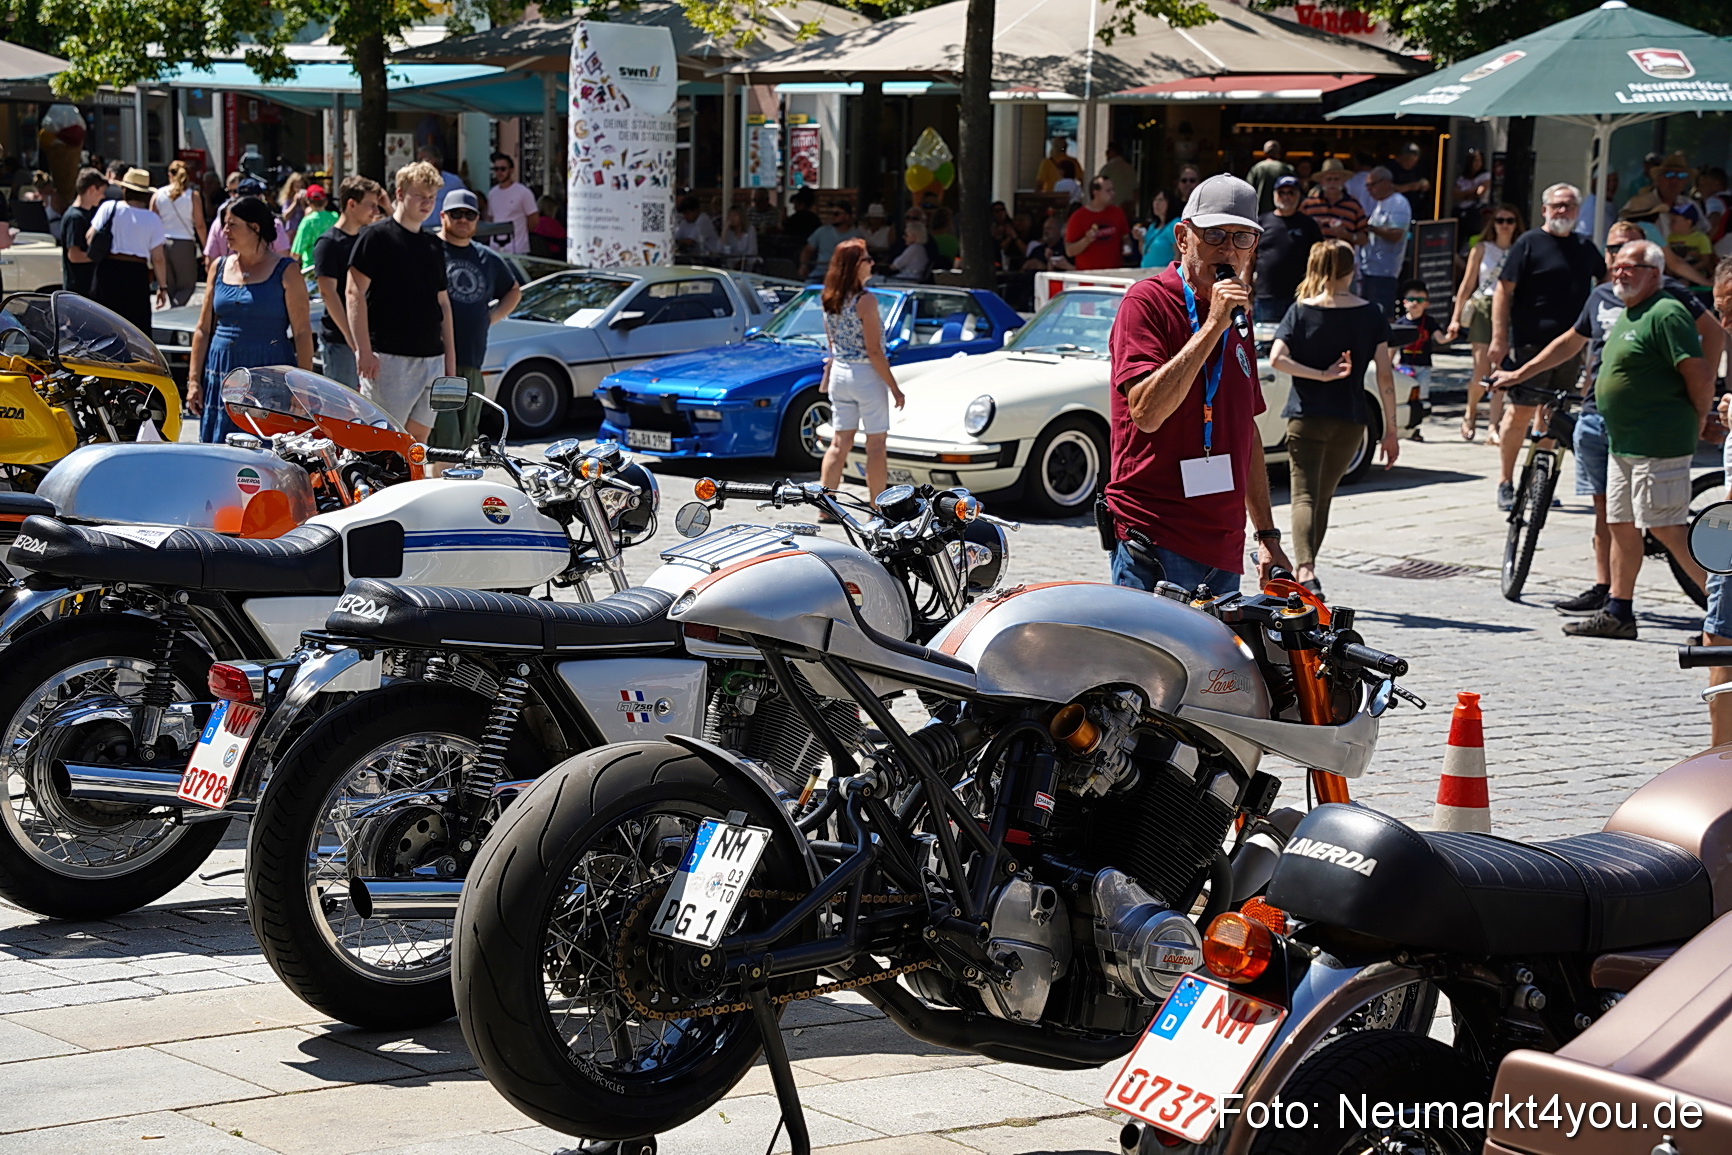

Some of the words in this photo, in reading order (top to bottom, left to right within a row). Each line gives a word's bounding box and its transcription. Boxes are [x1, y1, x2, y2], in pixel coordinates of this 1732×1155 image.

[619, 66, 648, 78] swn
[1627, 81, 1730, 93] Neumarkter
[237, 477, 260, 485] LAVERDA
[223, 704, 257, 737] NM
[205, 726, 214, 739] D
[182, 766, 228, 804] 0798
[711, 827, 753, 864] NM
[686, 852, 698, 867] D
[1283, 836, 1379, 878] LAVERDA
[727, 868, 744, 884] 03
[719, 888, 735, 904] 10
[658, 898, 697, 937] PG
[695, 909, 718, 941] 1
[1162, 954, 1194, 966] LAVERDA
[1160, 1013, 1178, 1031] D
[1201, 994, 1263, 1045] NM
[566, 1050, 626, 1095] MOTOR-UPCYCLES
[1116, 1067, 1217, 1130] 0737
